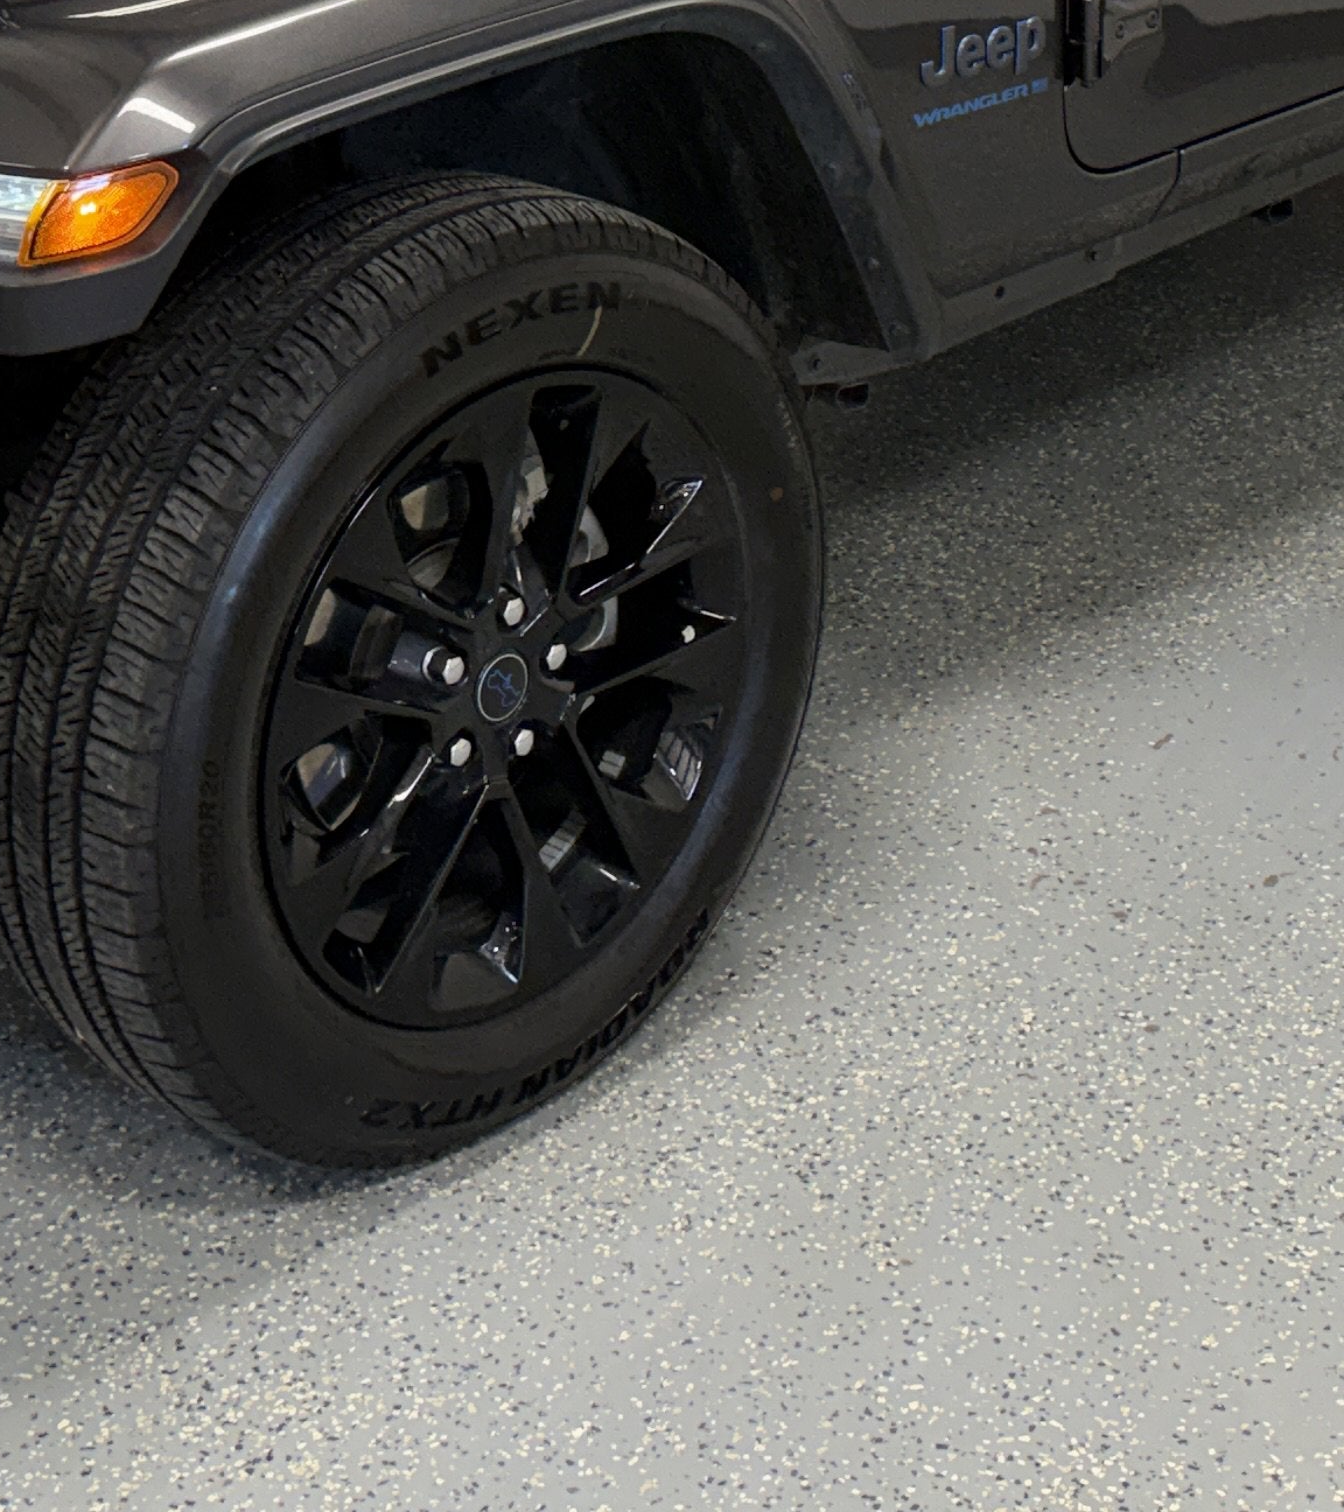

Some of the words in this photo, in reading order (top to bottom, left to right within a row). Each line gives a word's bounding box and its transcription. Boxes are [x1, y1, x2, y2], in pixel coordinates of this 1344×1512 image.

[920, 16, 1047, 88] Jeep
[913, 83, 1029, 128] WRANGLER
[420, 281, 622, 379] NEXEN
